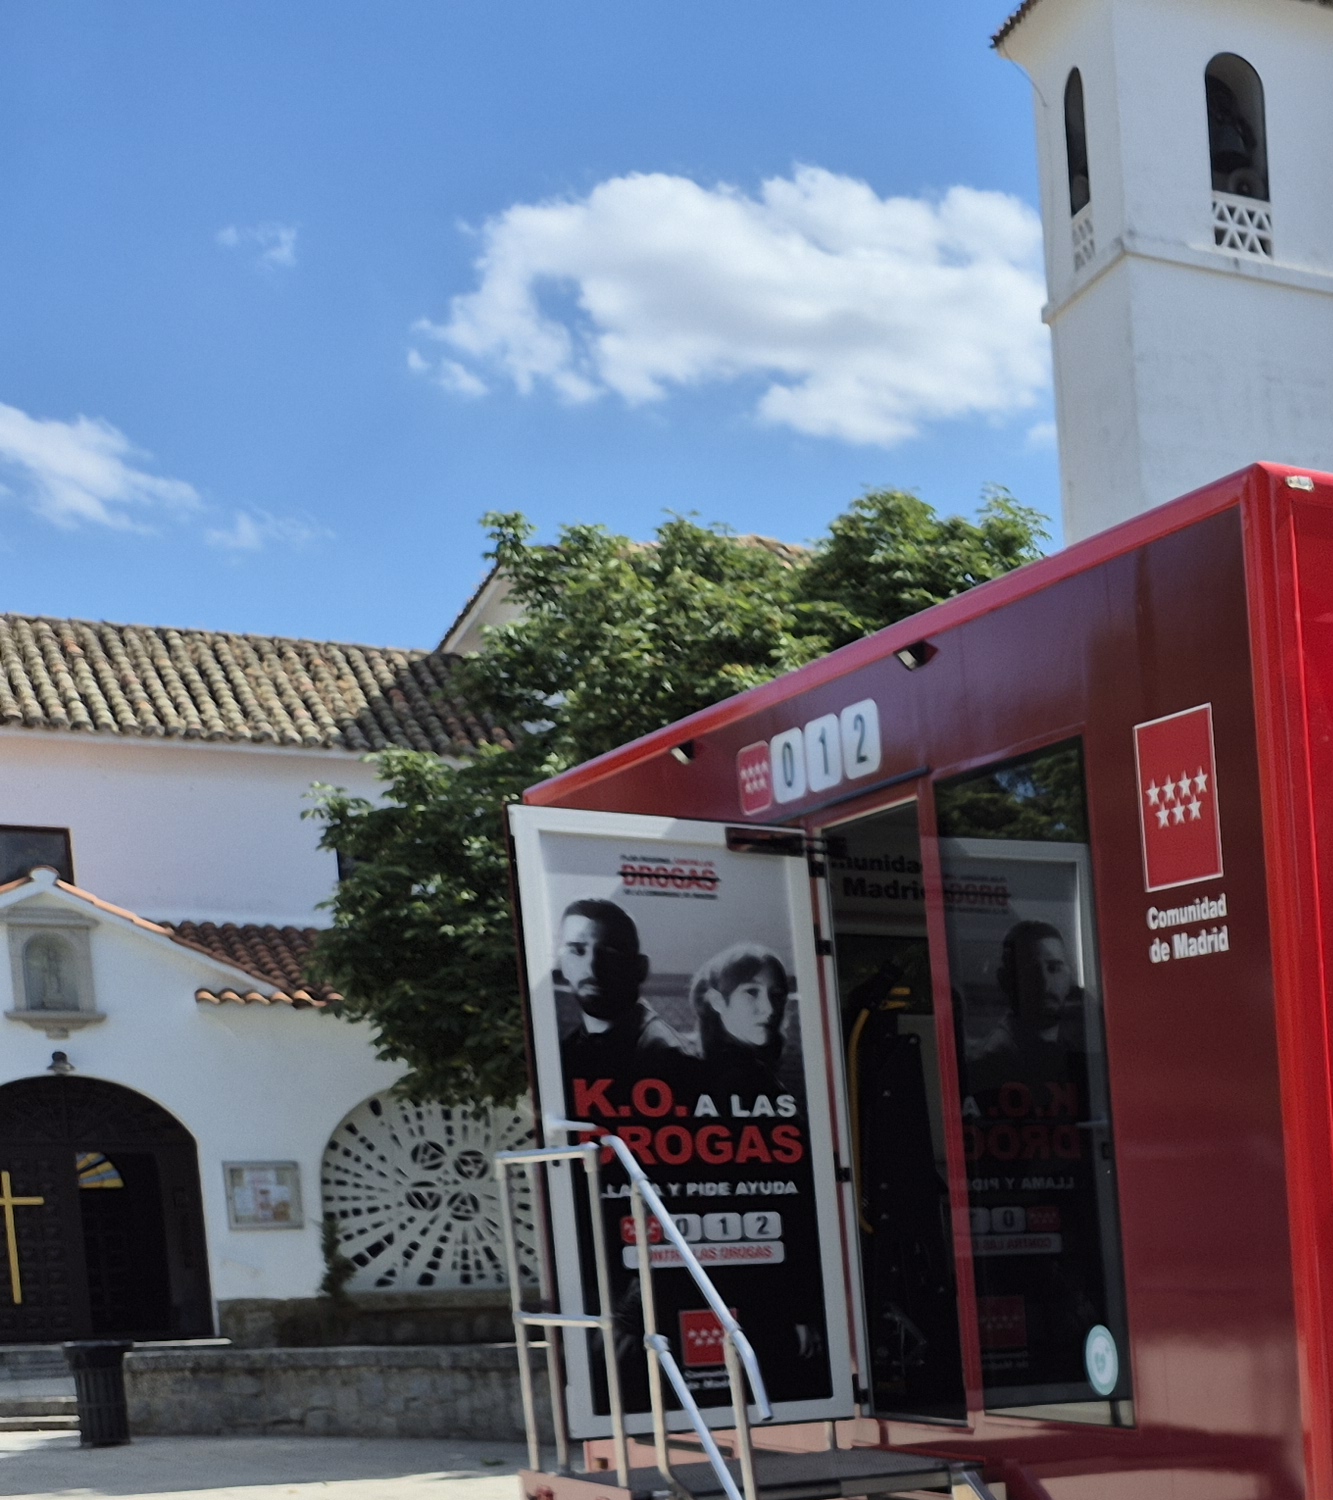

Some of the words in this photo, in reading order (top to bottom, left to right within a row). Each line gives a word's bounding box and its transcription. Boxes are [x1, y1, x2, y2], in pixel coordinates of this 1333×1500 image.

[842, 876, 926, 899] Madri
[1146, 892, 1228, 930] Comunidad
[1149, 937, 1170, 964] de
[1172, 925, 1229, 960] Madrid
[572, 1078, 689, 1118] K.O.
[694, 1094, 719, 1117] A
[730, 1094, 797, 1118] LAS
[667, 1183, 681, 1196] Y
[686, 1181, 732, 1196] PIDE
[735, 1181, 799, 1196] AYUDA
[675, 1216, 770, 1237] 012
